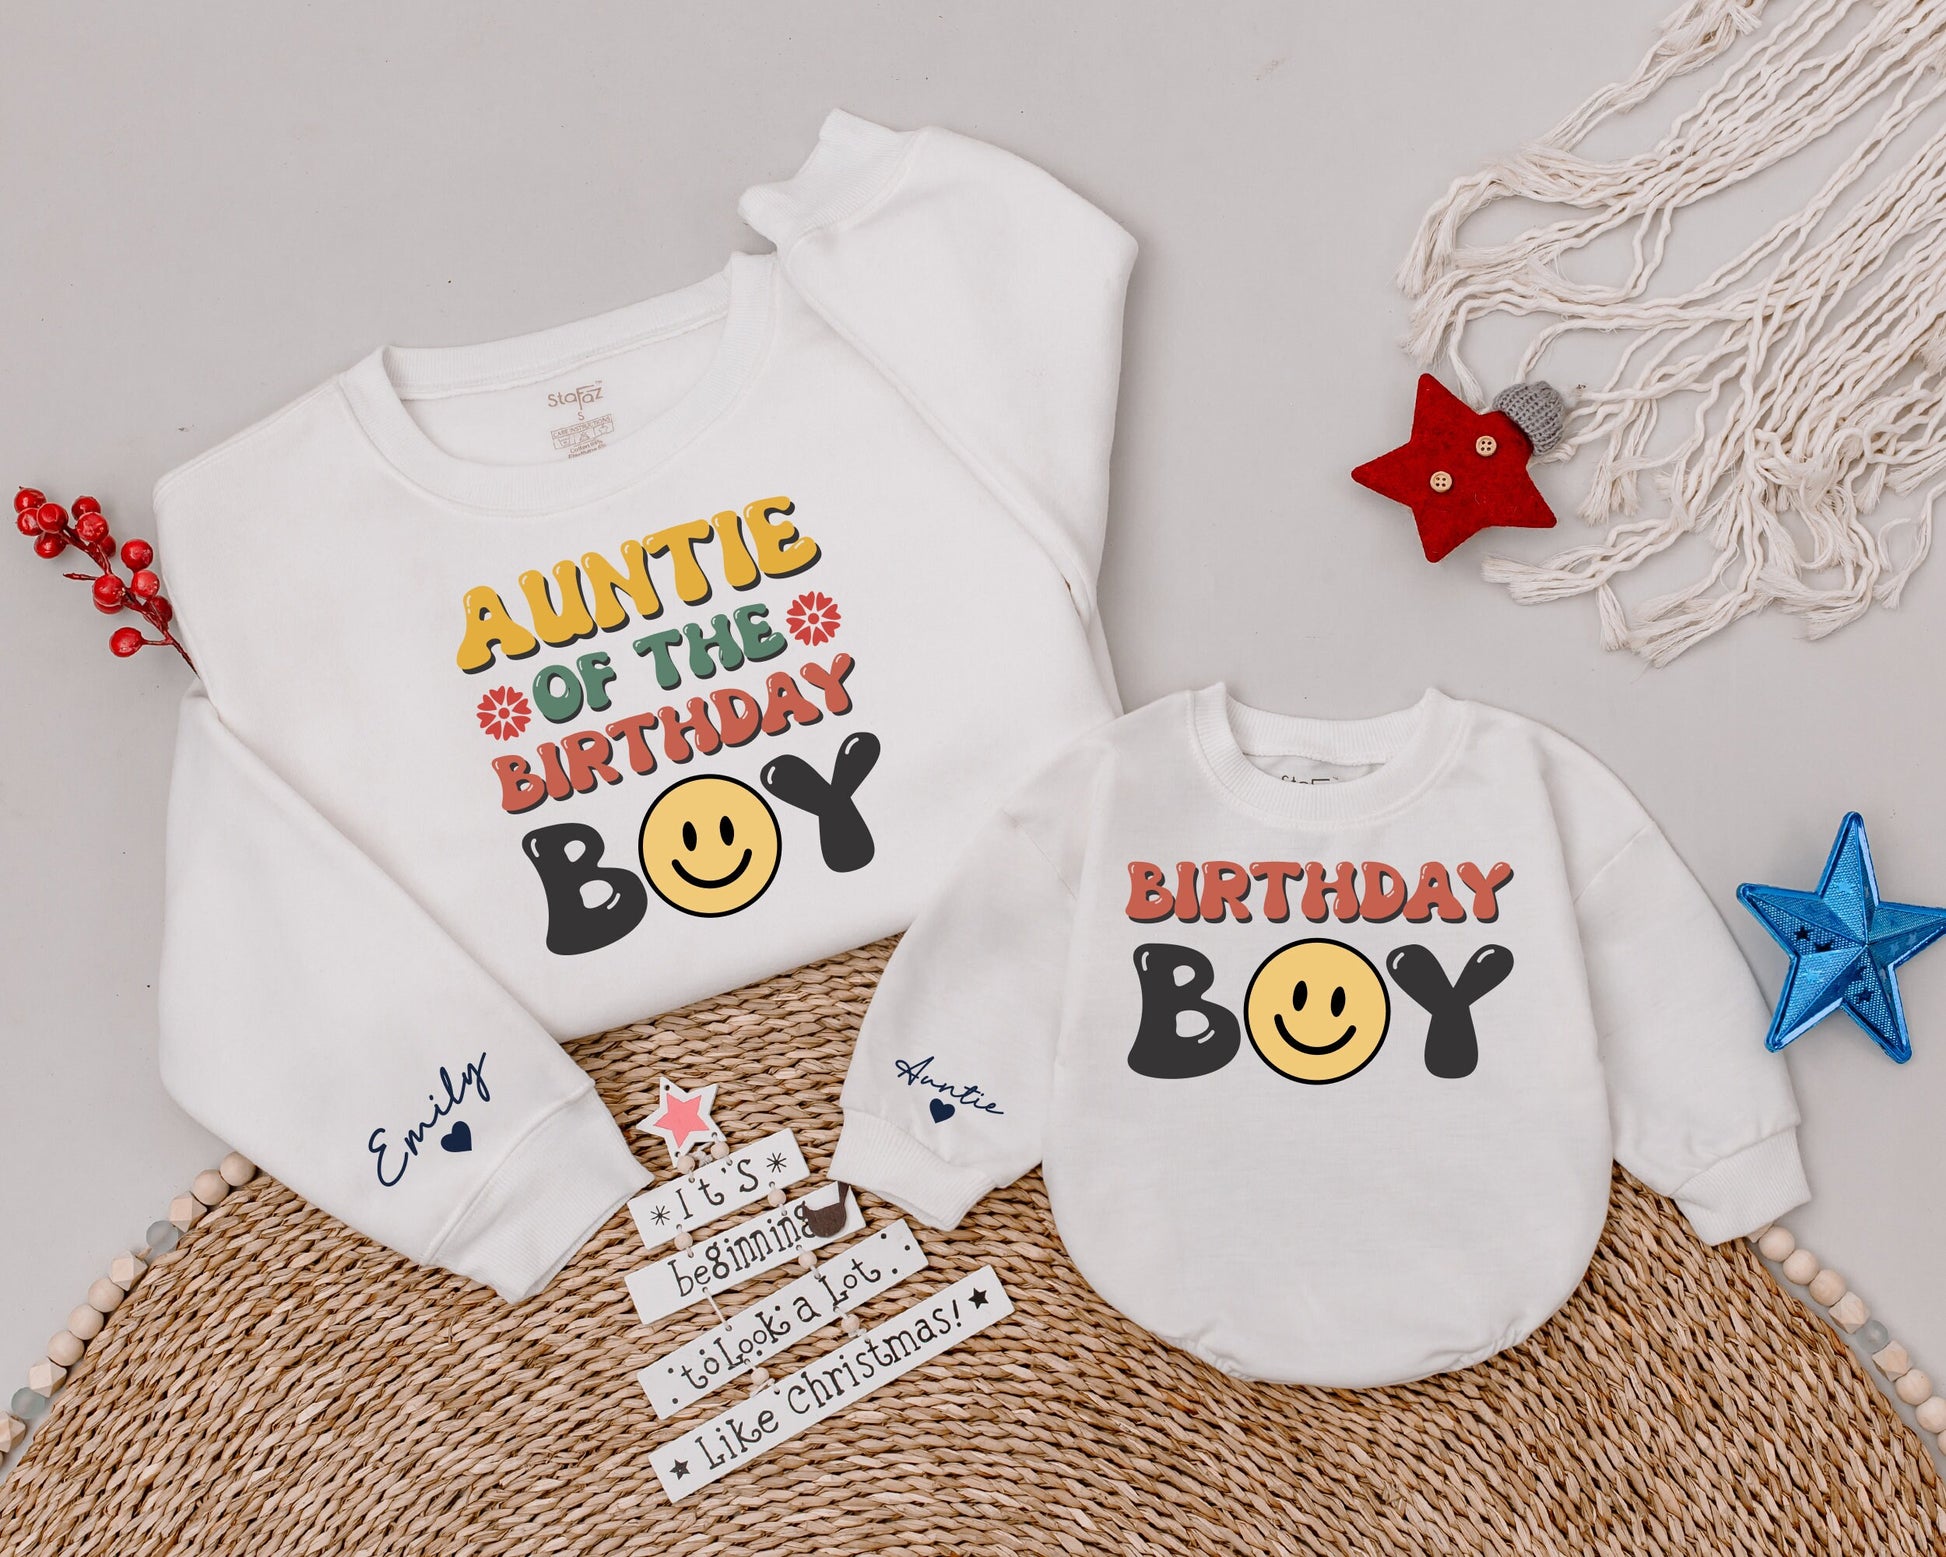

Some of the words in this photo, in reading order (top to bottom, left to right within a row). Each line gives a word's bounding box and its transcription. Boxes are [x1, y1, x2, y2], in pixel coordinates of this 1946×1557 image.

[577, 411, 585, 421] S
[456, 495, 822, 674] AUNTIE
[531, 651, 617, 724] OF
[632, 603, 788, 691] THE
[491, 653, 855, 815] BIRTHDAY
[1125, 860, 1514, 924] BIRTHDAY
[368, 1052, 491, 1187] Emily
[895, 1056, 1004, 1115] Auntie
[680, 1356, 720, 1390] to
[792, 1296, 821, 1323] a
[695, 1409, 779, 1470] Like
